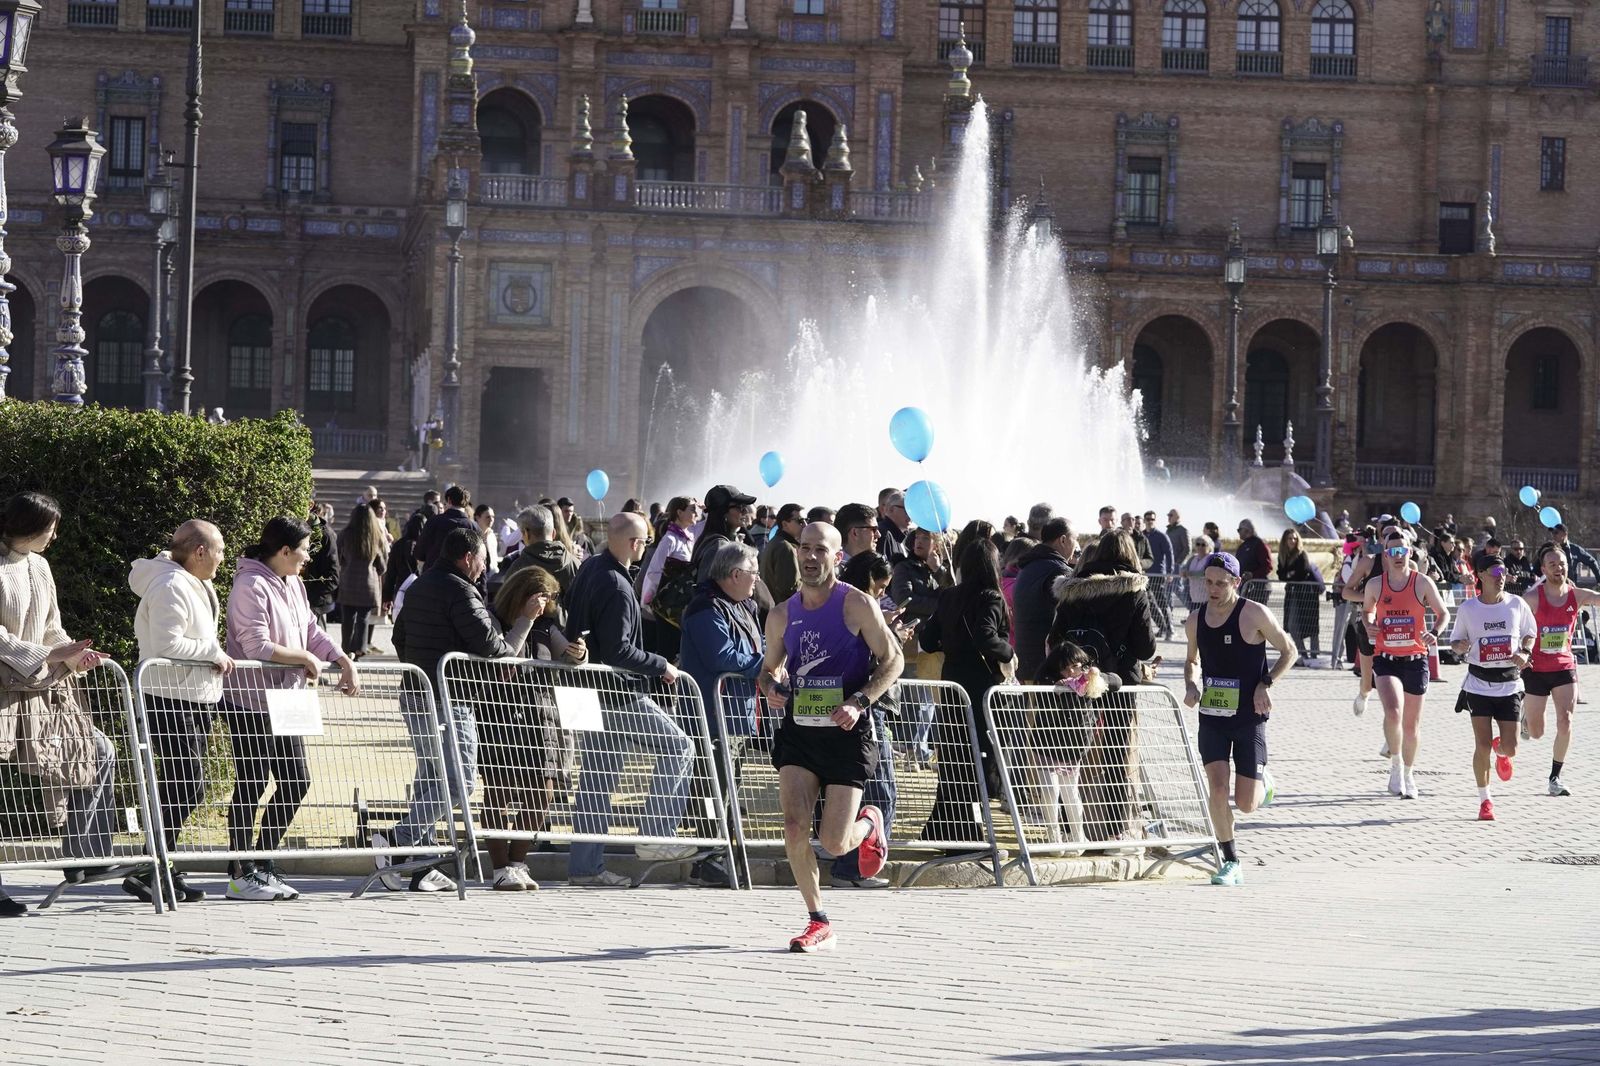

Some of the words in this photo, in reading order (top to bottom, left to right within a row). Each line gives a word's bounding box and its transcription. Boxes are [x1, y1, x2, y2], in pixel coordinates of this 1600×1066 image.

[1386, 632, 1411, 640] WRIGHT
[807, 679, 836, 687] ZURICH
[1210, 698, 1229, 708] NIELS
[797, 705, 812, 715] GUY
